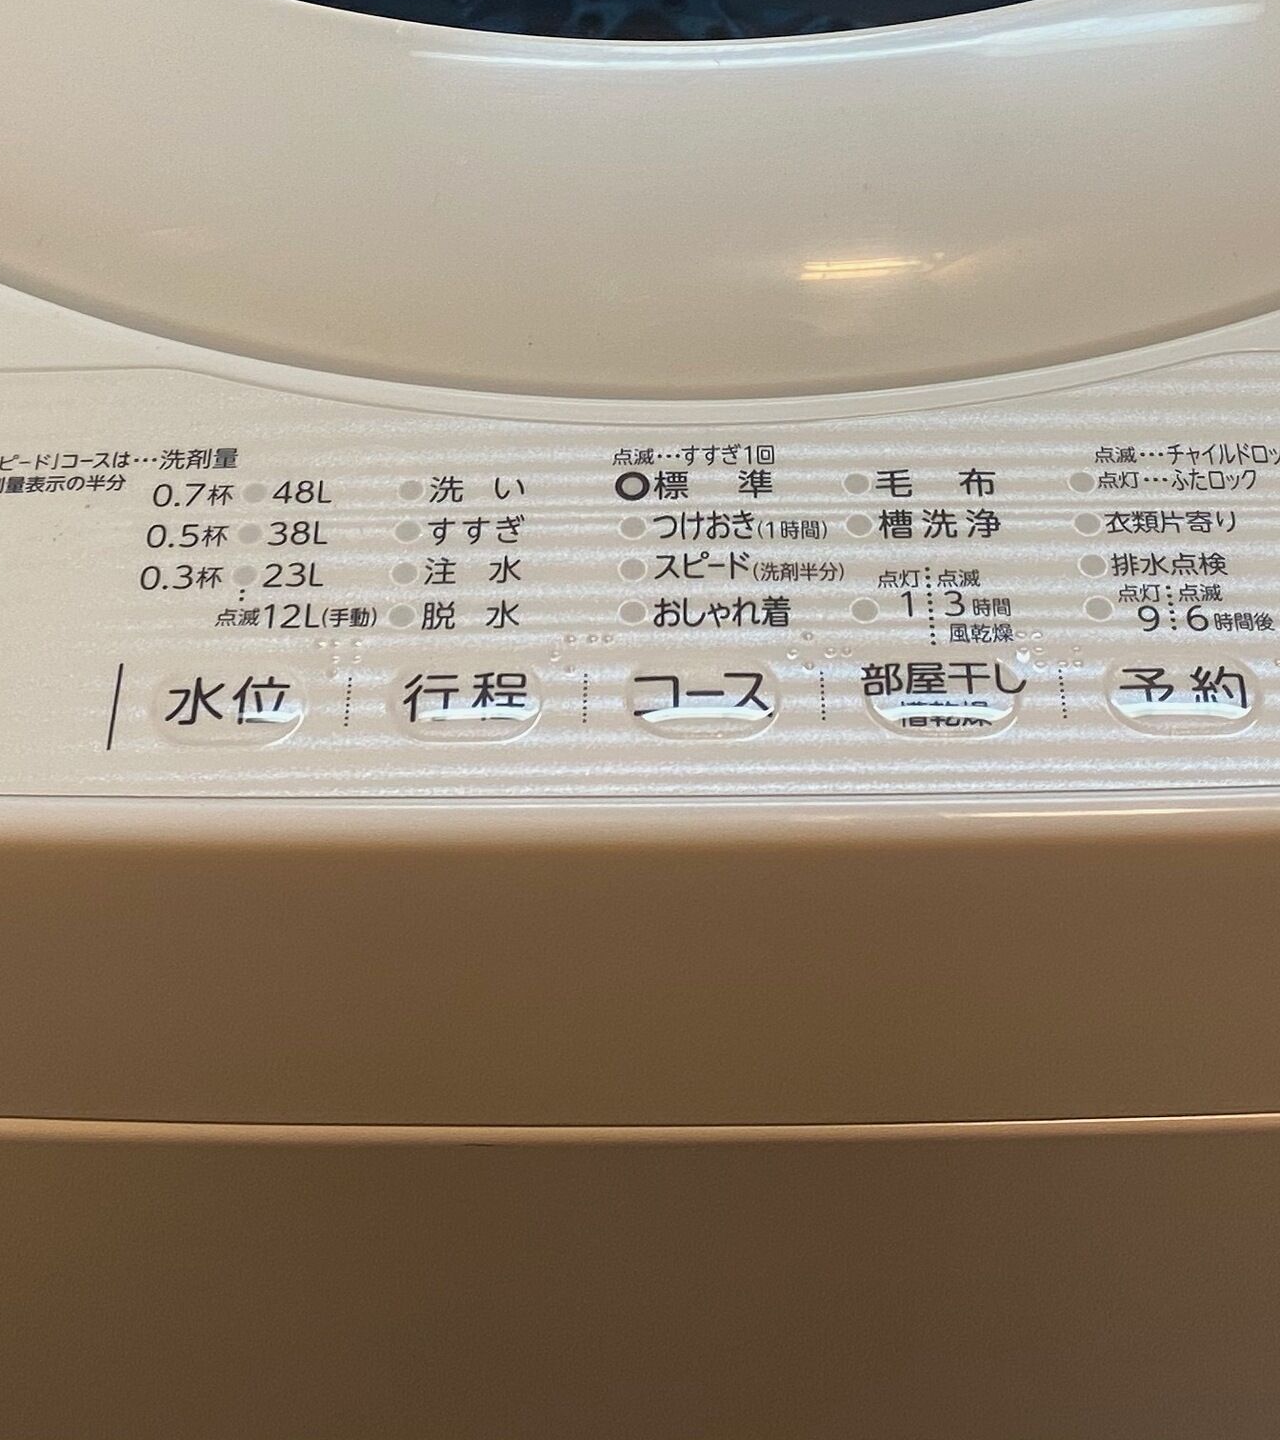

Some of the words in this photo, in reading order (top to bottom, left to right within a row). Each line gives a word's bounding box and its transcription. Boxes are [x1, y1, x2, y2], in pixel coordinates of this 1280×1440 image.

[152, 483, 235, 507] 0.7杯
[272, 480, 332, 504] 48L
[146, 524, 229, 548] 0.5杯
[267, 521, 328, 546] 38L
[428, 514, 526, 545] すすぎ
[878, 508, 1001, 540] 槽洗浄
[1104, 509, 1237, 534] 衣類片寄り
[139, 564, 223, 590] 0.3杯
[262, 562, 324, 588] 23L
[1111, 552, 1229, 578] 排水点検
[878, 570, 920, 589] 点灯
[936, 569, 981, 588] 点滅
[1118, 584, 1160, 603] 点灯
[1178, 582, 1223, 602] 点滅
[653, 596, 791, 628] おしゃれ着
[900, 591, 914, 617] 1
[1138, 605, 1160, 632] 9
[949, 624, 1014, 643] 風乾燥
[860, 661, 1027, 697] 部屋干し
[1120, 665, 1247, 709] 予約
[165, 675, 292, 725] 水位
[403, 672, 528, 723] 行程
[633, 671, 773, 718] コース
